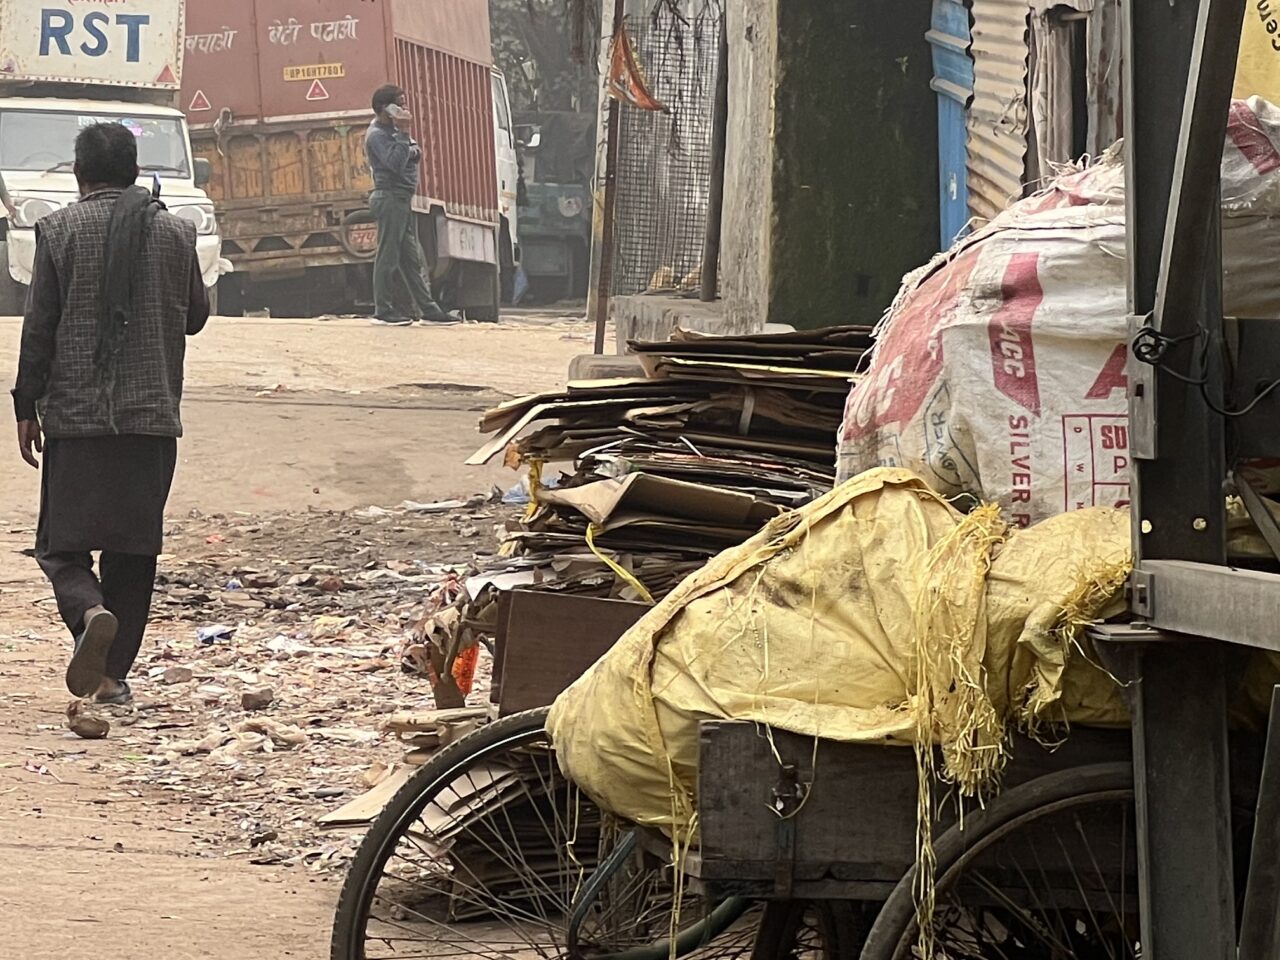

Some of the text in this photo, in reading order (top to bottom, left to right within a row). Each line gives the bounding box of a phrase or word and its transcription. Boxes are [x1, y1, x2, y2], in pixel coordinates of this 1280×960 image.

[38, 7, 150, 63] RST
[999, 320, 1025, 380] ACC
[1008, 414, 1032, 504] SILVER
